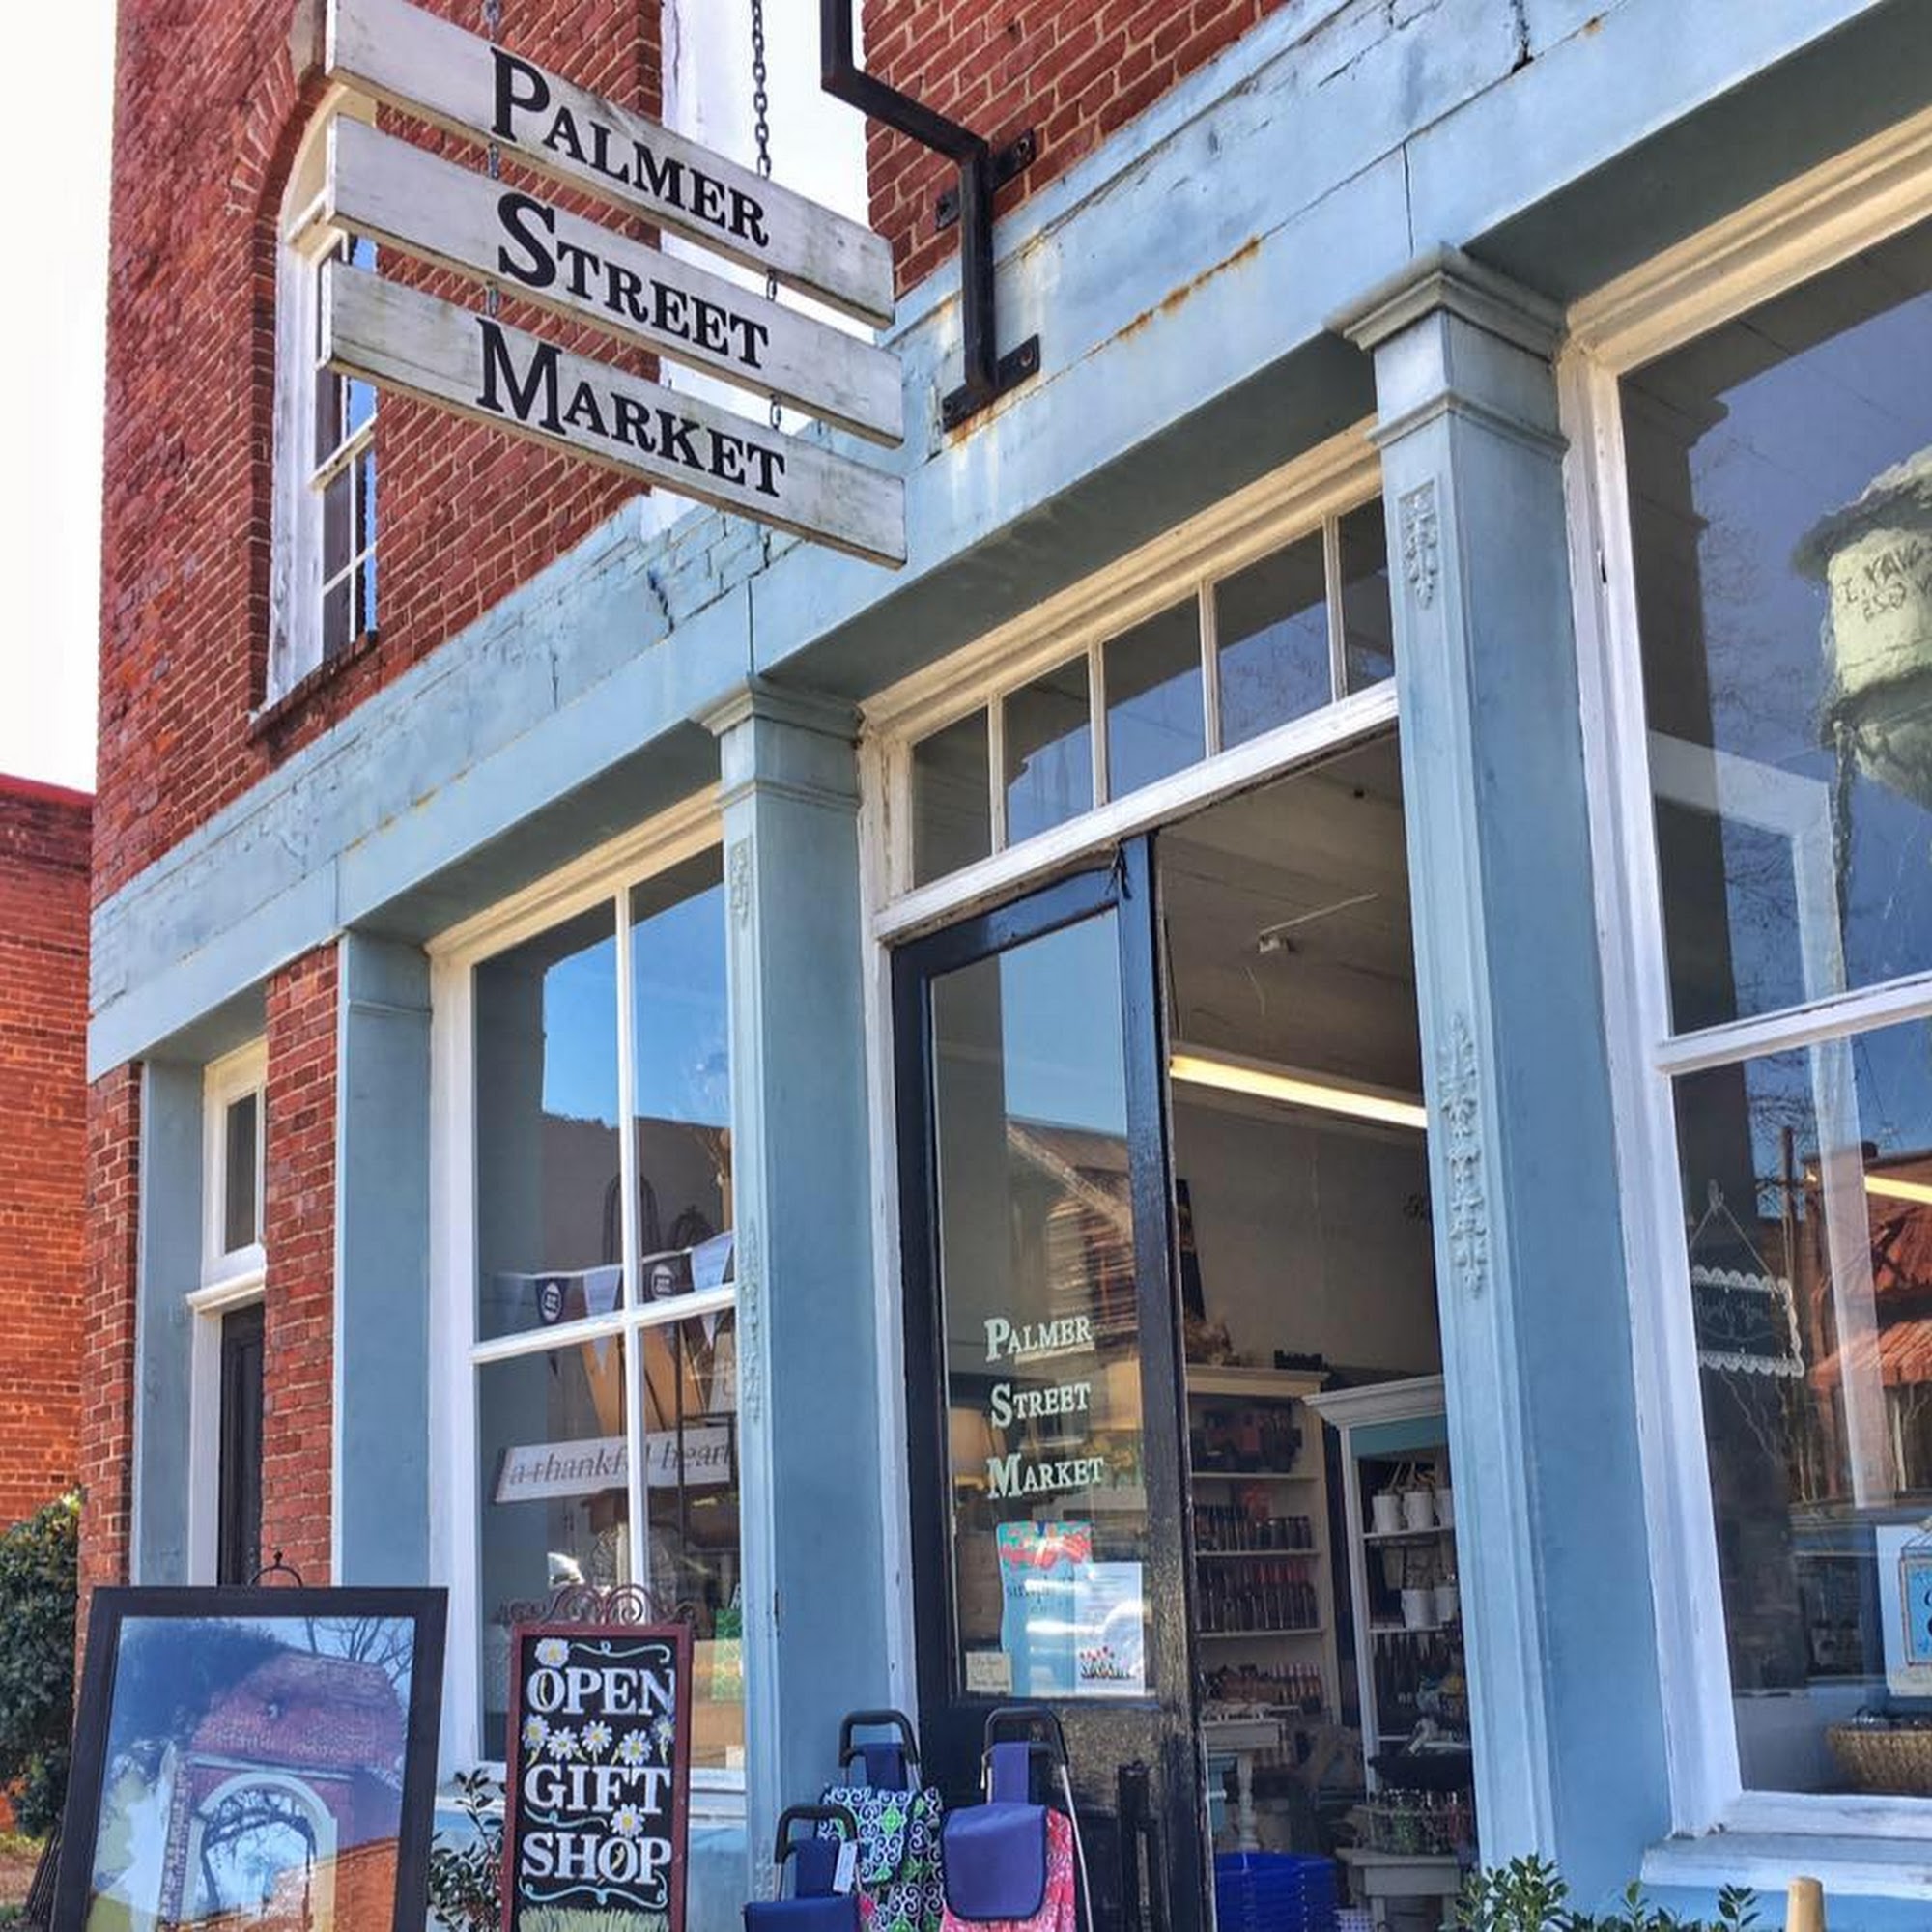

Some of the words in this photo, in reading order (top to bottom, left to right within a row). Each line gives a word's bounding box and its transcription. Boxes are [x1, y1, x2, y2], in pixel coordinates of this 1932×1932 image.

[490, 46, 770, 248] PALMER
[498, 192, 770, 369] STREET
[475, 317, 786, 498] MARKET
[984, 1316, 1094, 1363] PALMER
[991, 1382, 1092, 1430] STREET
[528, 1442, 651, 1484] thankfl
[986, 1453, 1105, 1499] MARKET
[526, 1667, 676, 1716] OPEN
[524, 1764, 672, 1814] GIFT
[521, 1832, 672, 1885] SHOP
